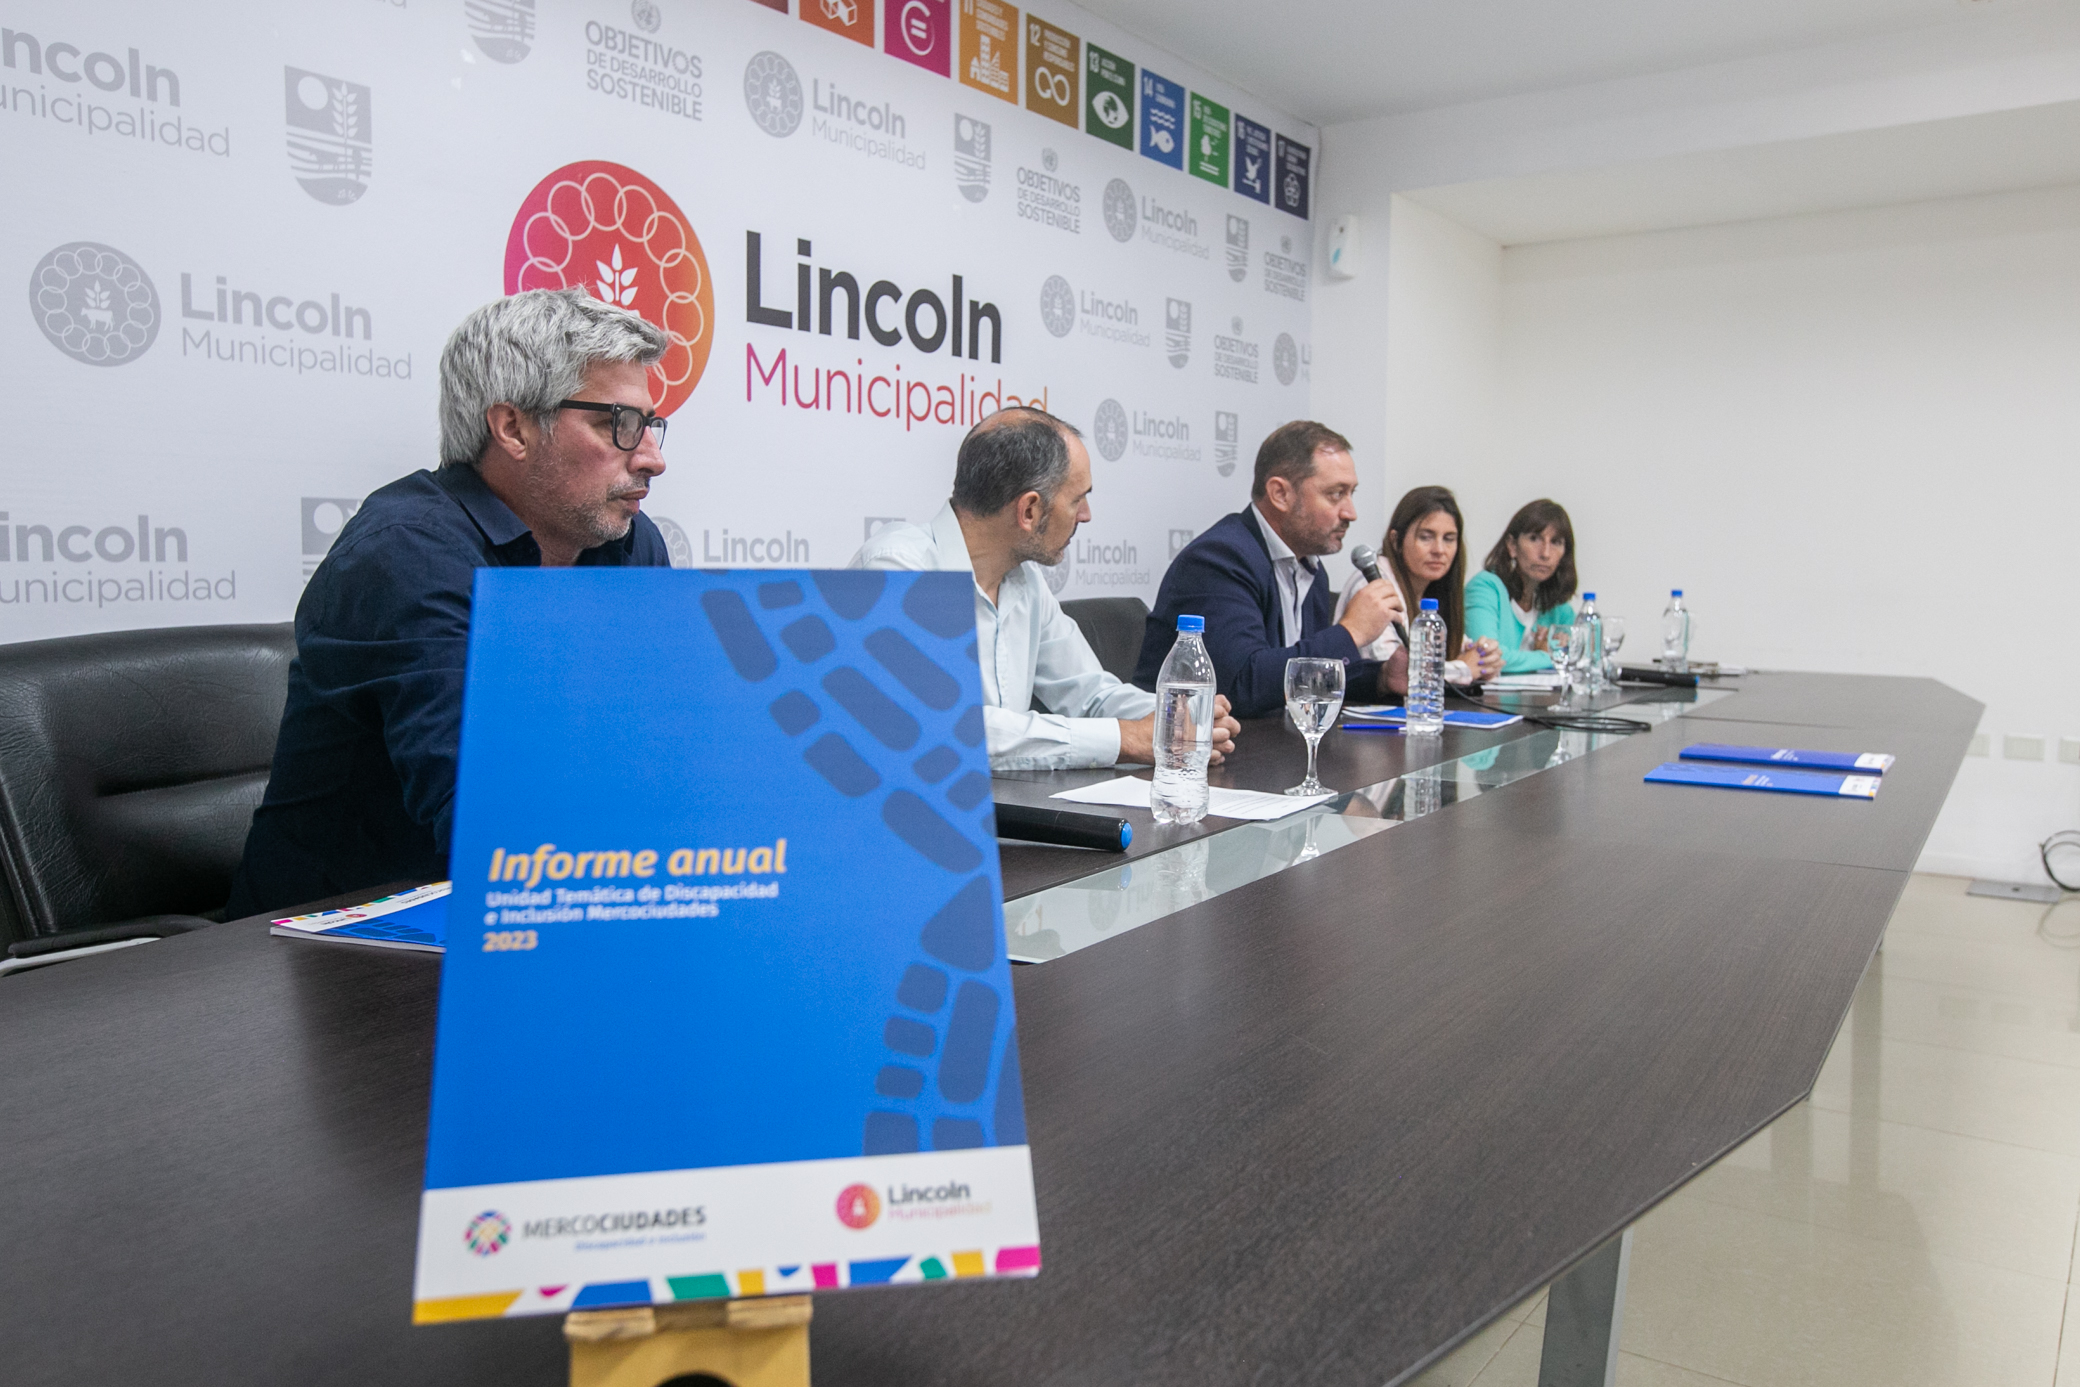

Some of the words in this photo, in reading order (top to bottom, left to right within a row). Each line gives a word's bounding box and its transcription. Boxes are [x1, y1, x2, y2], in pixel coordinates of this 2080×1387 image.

[585, 20, 703, 79] OBJETIVOS
[587, 48, 607, 69] DE
[610, 56, 703, 98] DESARROLLO
[587, 68, 703, 122] SOSTENIBLE
[813, 77, 906, 139] Lincoln
[812, 115, 926, 171] Municipalidad
[1016, 166, 1081, 203] OBJETIVOS
[1017, 201, 1081, 234] SOSTENIBLE
[1142, 195, 1198, 237] Lincoln
[181, 272, 372, 341] Lincoln
[746, 229, 1002, 364] Lincoln
[1080, 289, 1138, 325] Lincoln
[182, 327, 412, 380] Municipalidad
[1133, 411, 1190, 441] Lincoln
[703, 528, 810, 563] Lincoln
[1076, 538, 1138, 564] Lincoln
[1075, 568, 1150, 588] Municipalidad
[488, 844, 659, 888] Informe
[667, 838, 788, 876] anual
[486, 887, 552, 907] Unidad
[636, 884, 662, 902] de
[664, 880, 780, 903] Discapacidad
[483, 910, 499, 926] e
[482, 929, 539, 952] 2023
[888, 1181, 971, 1205] Lincoln
[522, 1205, 707, 1239] MERCOCIUDADES
